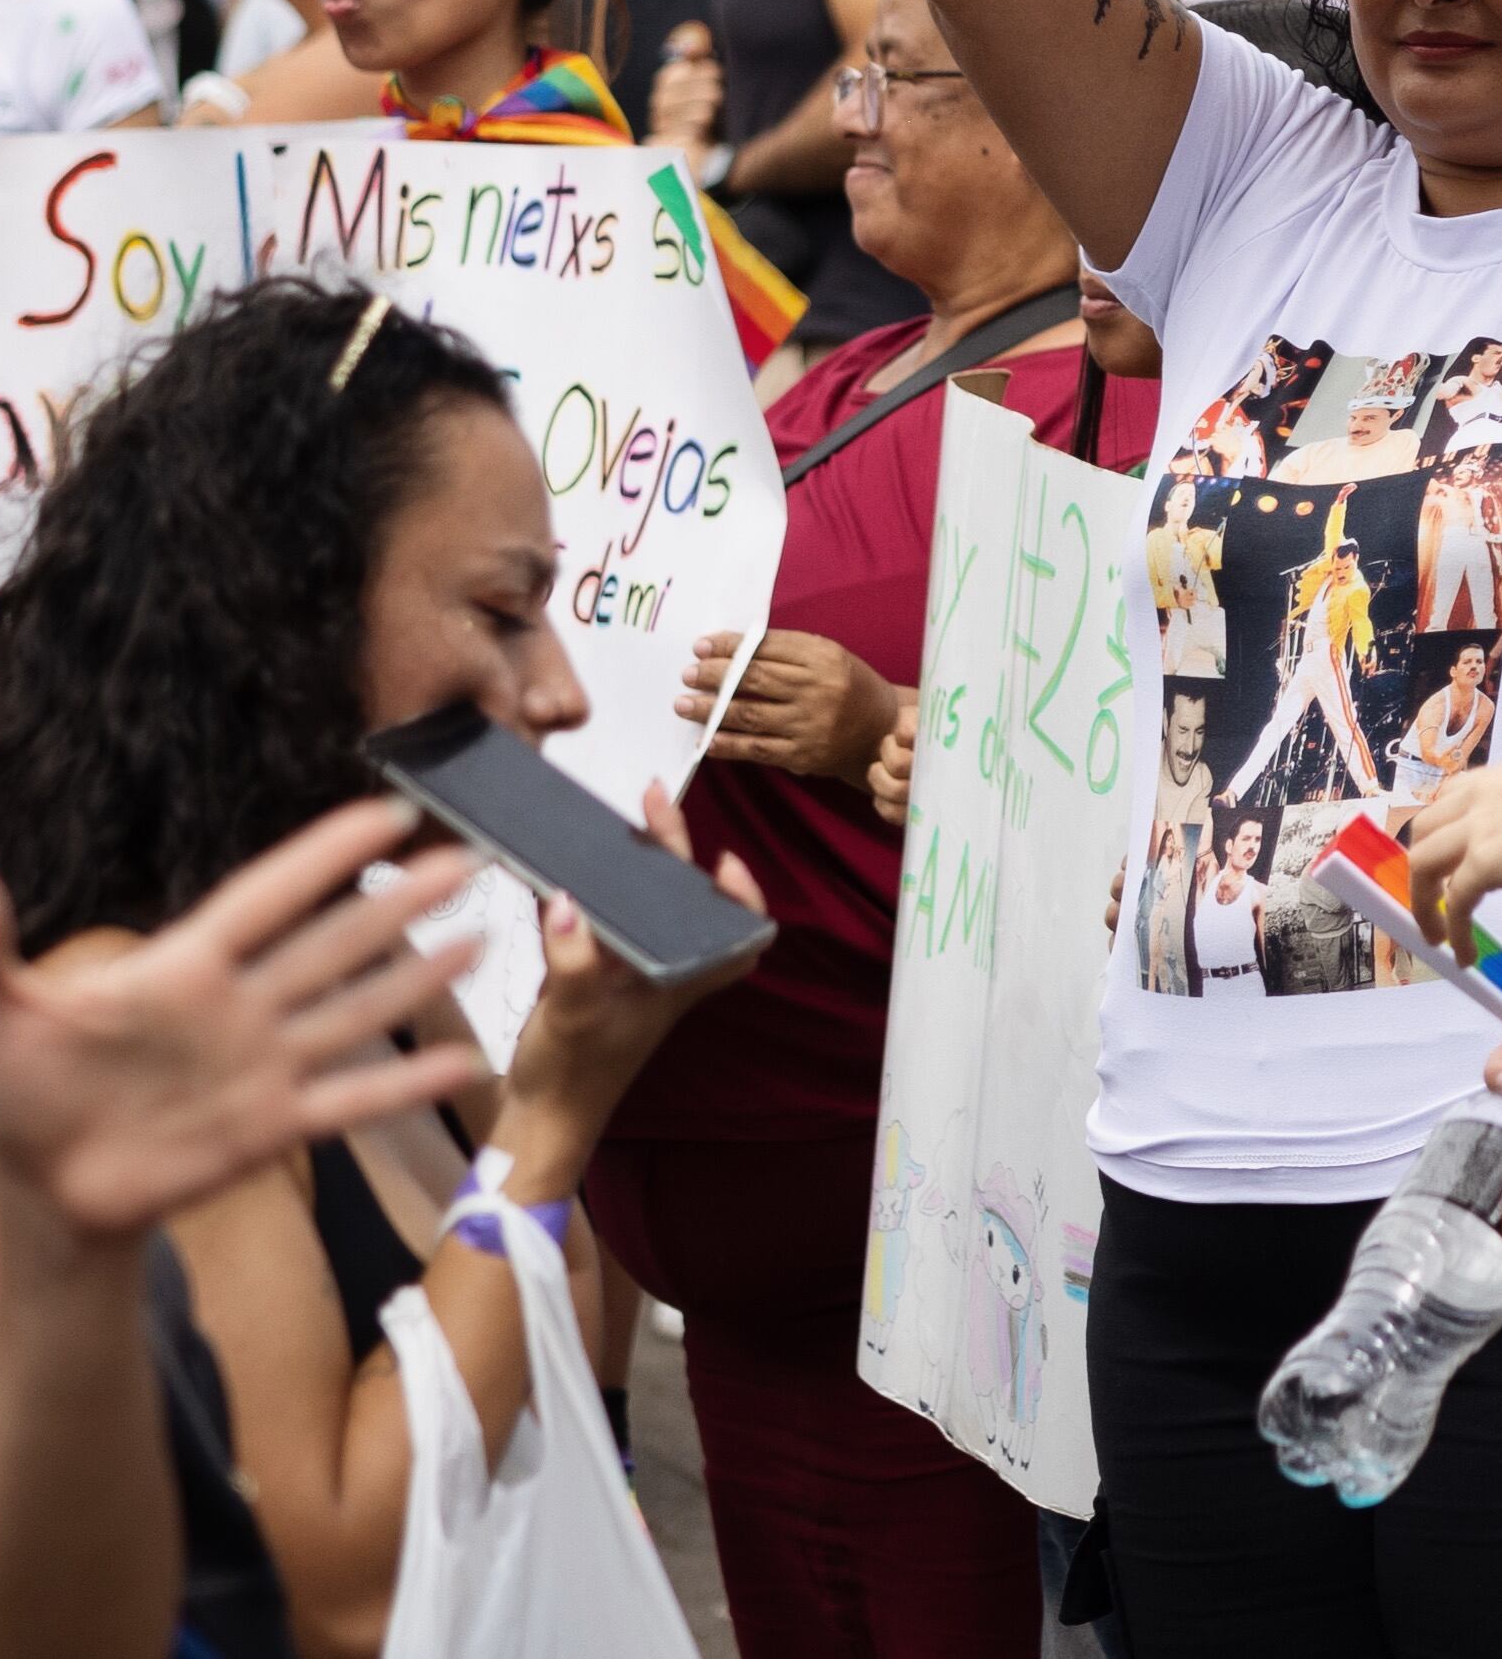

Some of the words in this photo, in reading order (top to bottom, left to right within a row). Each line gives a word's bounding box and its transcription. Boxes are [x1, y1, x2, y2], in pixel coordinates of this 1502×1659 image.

[17, 151, 206, 333] Soy
[299, 147, 444, 270] Mis
[459, 163, 618, 278] nietxs
[542, 382, 738, 559] Ovejas
[572, 541, 619, 629] de
[624, 577, 672, 632] mi
